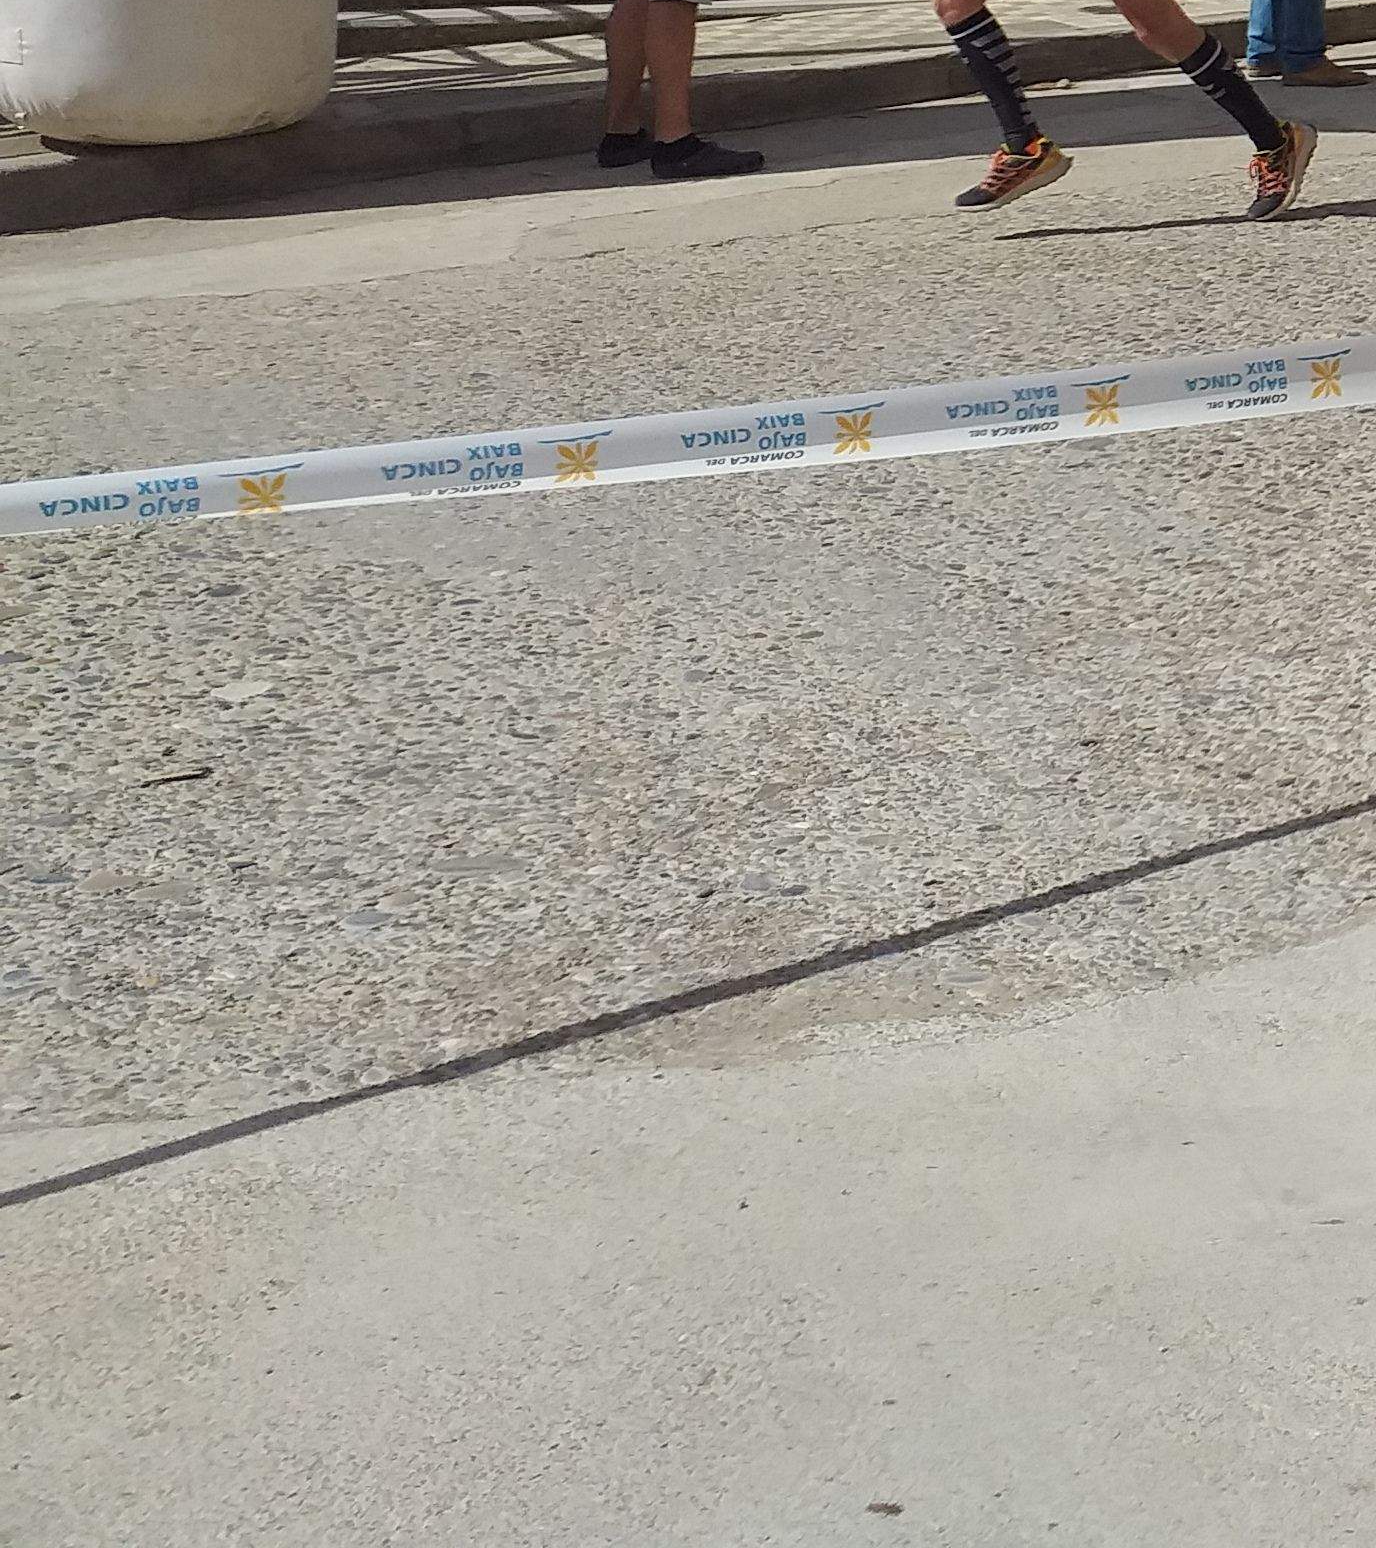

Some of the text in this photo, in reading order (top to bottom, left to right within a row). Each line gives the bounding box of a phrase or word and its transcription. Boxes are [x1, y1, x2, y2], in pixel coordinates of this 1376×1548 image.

[1245, 359, 1285, 375] BAIX
[1185, 372, 1288, 392] BAJO CINCA
[1012, 386, 1057, 401] BAIX
[1227, 393, 1288, 409] COMARCA
[946, 400, 1059, 420] BAJO CINCA
[755, 412, 805, 430] BAIX
[991, 421, 1059, 437] COMARCA
[681, 428, 807, 450] BAJO CINCA
[467, 442, 522, 460] BAIX
[730, 450, 804, 465] COMARCA
[381, 458, 523, 482] BAJO CINCA
[135, 476, 198, 495] BAIX
[438, 481, 521, 496] COMARCA
[39, 494, 200, 518] BAJO CINCA
